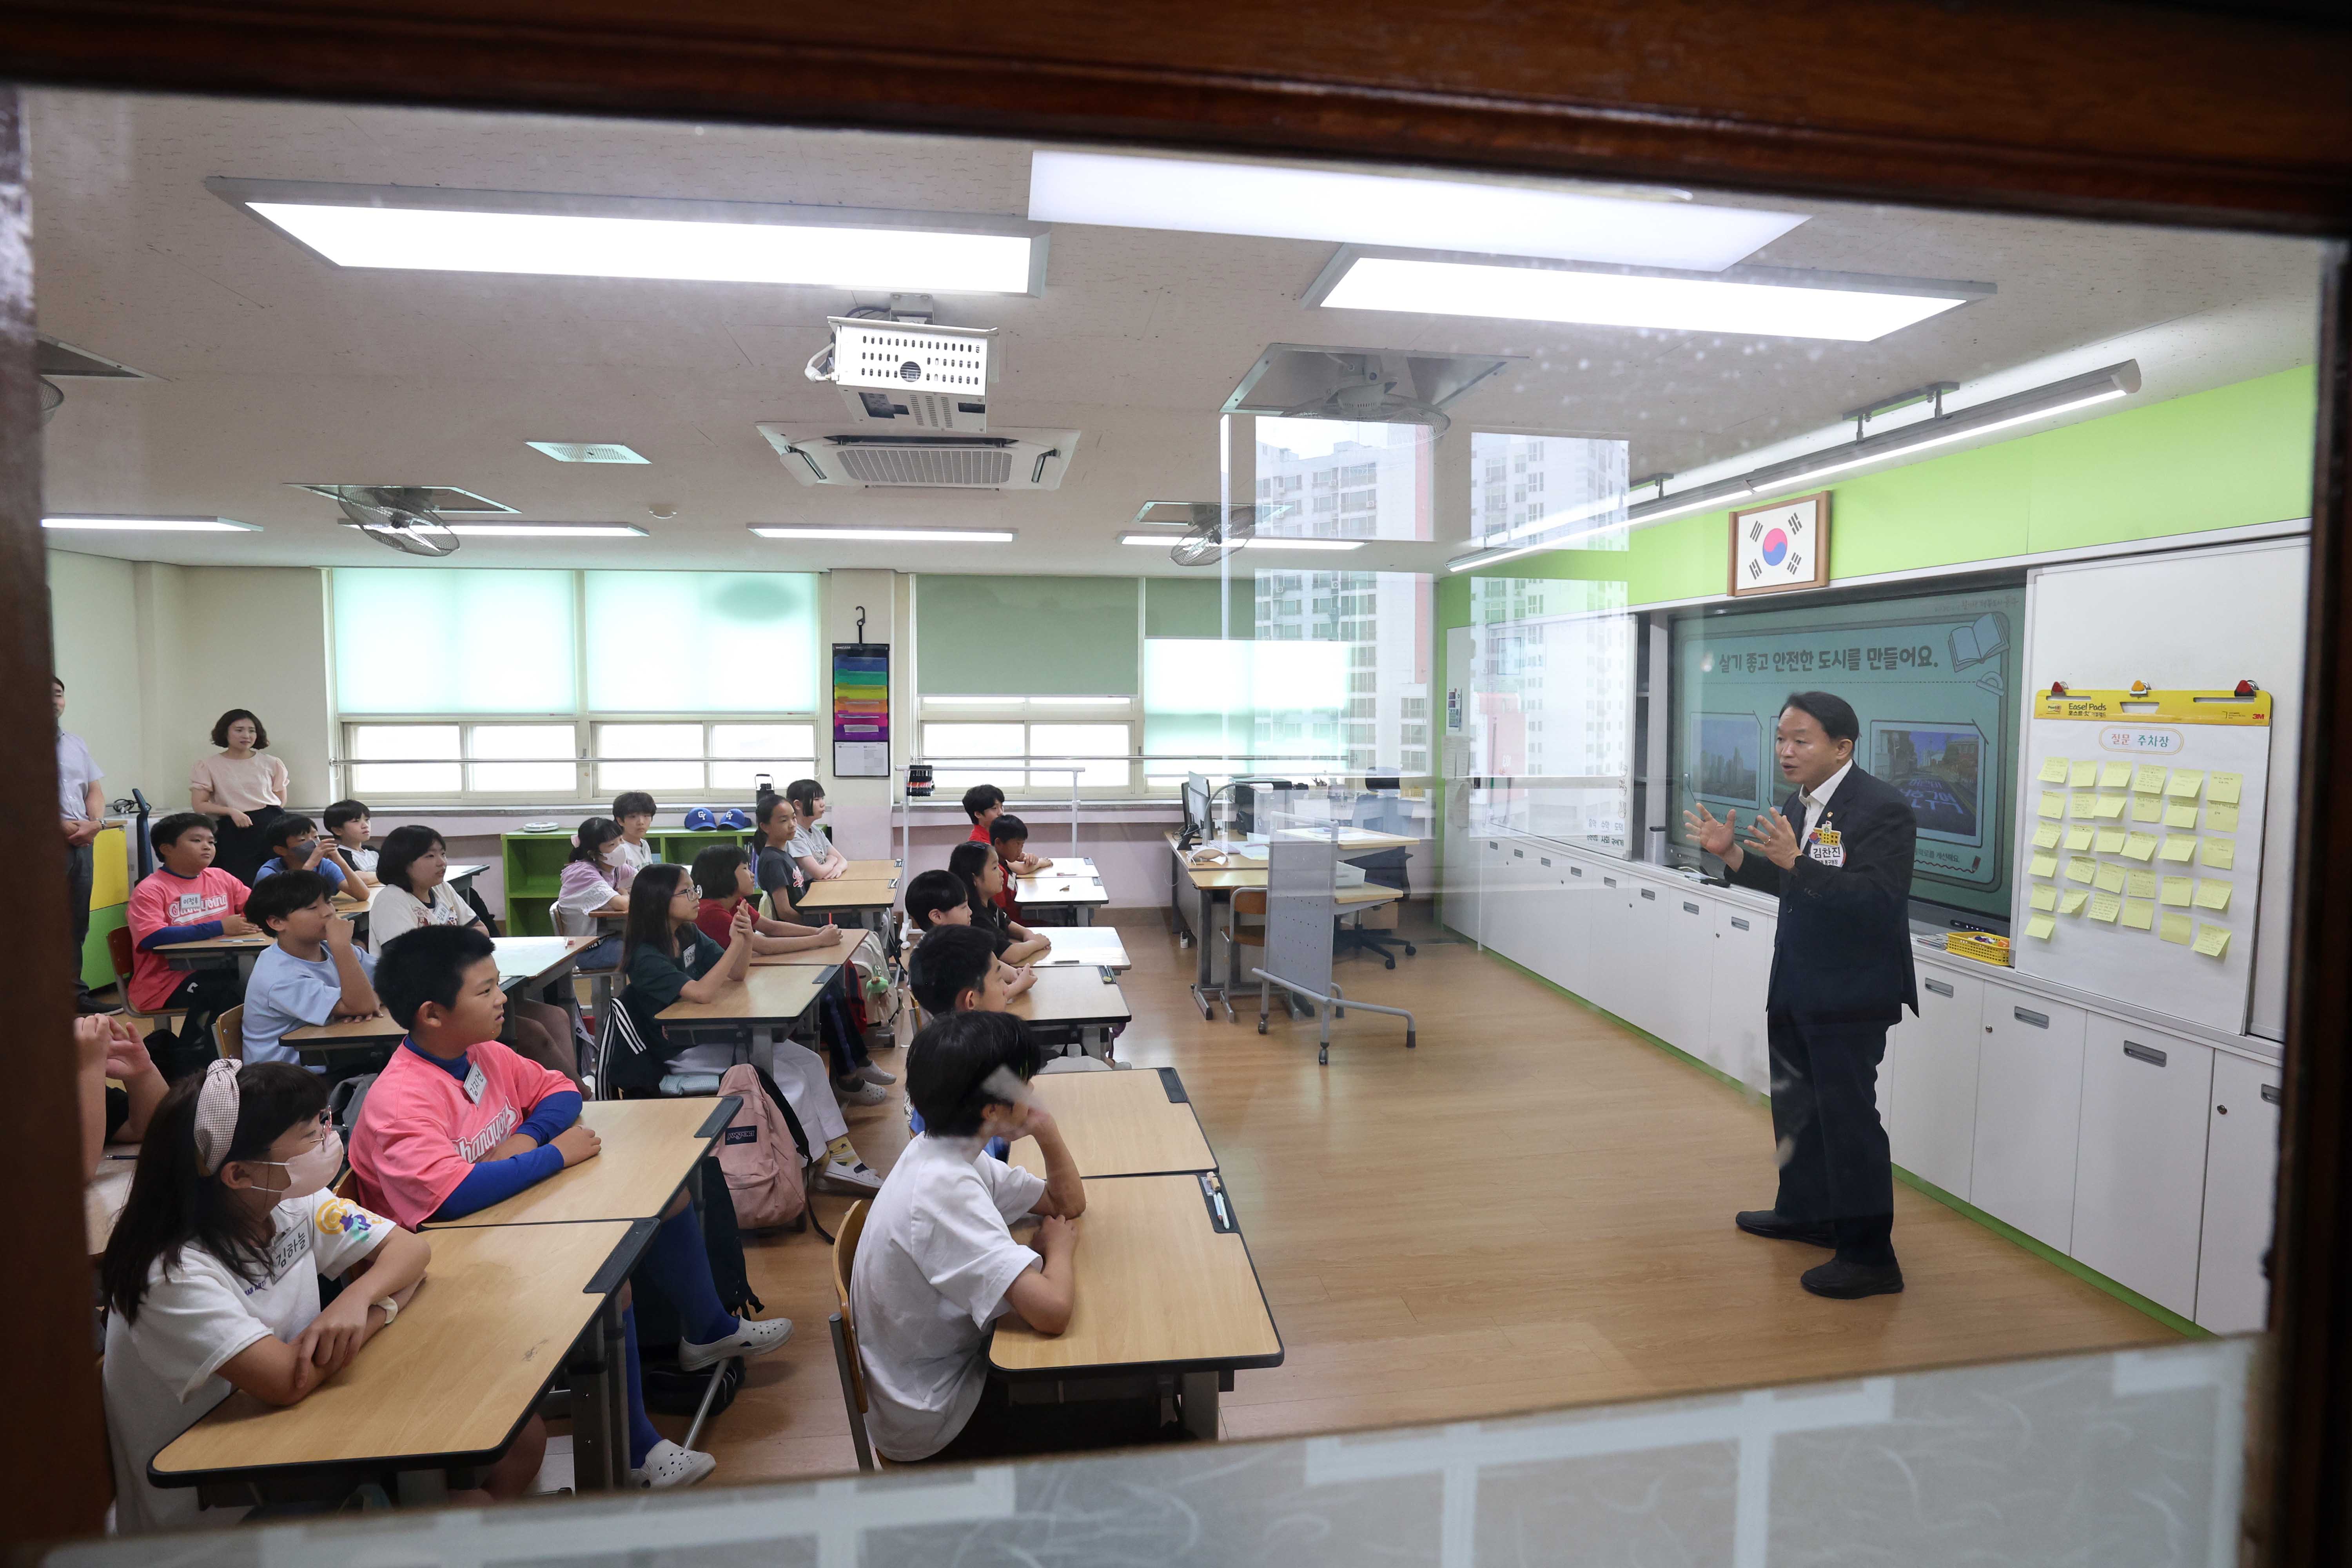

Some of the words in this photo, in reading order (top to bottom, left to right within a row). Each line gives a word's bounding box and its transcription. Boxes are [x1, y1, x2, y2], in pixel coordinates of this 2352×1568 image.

[1719, 654, 1742, 673] 살기
[1747, 652, 1768, 673] 좋고
[1773, 649, 1814, 672] 안전한
[1818, 648, 1861, 671] 도시를
[1867, 645, 1938, 670] 만들어요.
[2112, 733, 2130, 745] 질문
[2137, 735, 2169, 748] 주차장
[1813, 847, 1840, 858] 김찬진
[727, 1130, 755, 1140] JANSPORT
[276, 1232, 305, 1268] 김하늘
